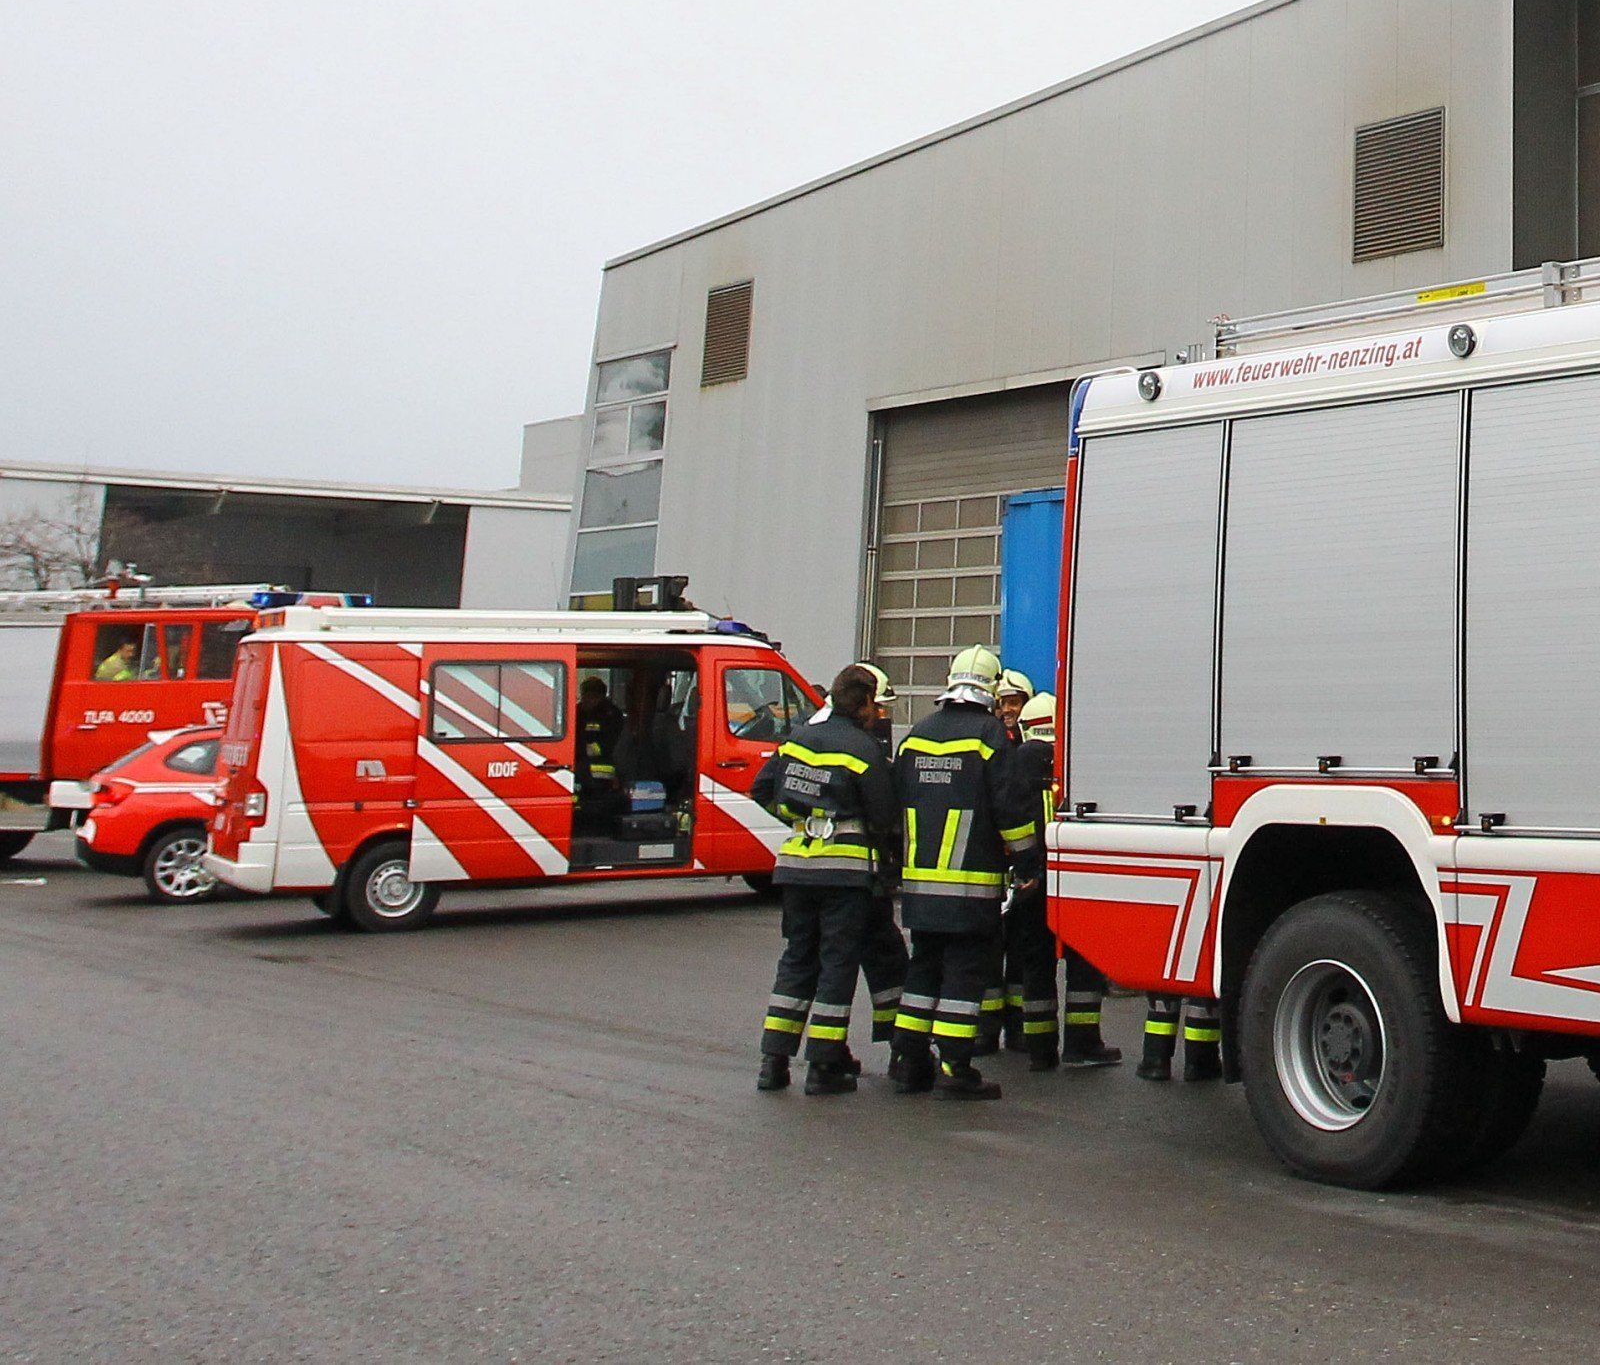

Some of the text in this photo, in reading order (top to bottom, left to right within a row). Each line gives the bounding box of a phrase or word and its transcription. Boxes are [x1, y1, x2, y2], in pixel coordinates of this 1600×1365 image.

[1193, 336, 1422, 389] www.feuerwehr-nenzing.at
[118, 710, 155, 723] 4000
[487, 762, 519, 777] KDOF
